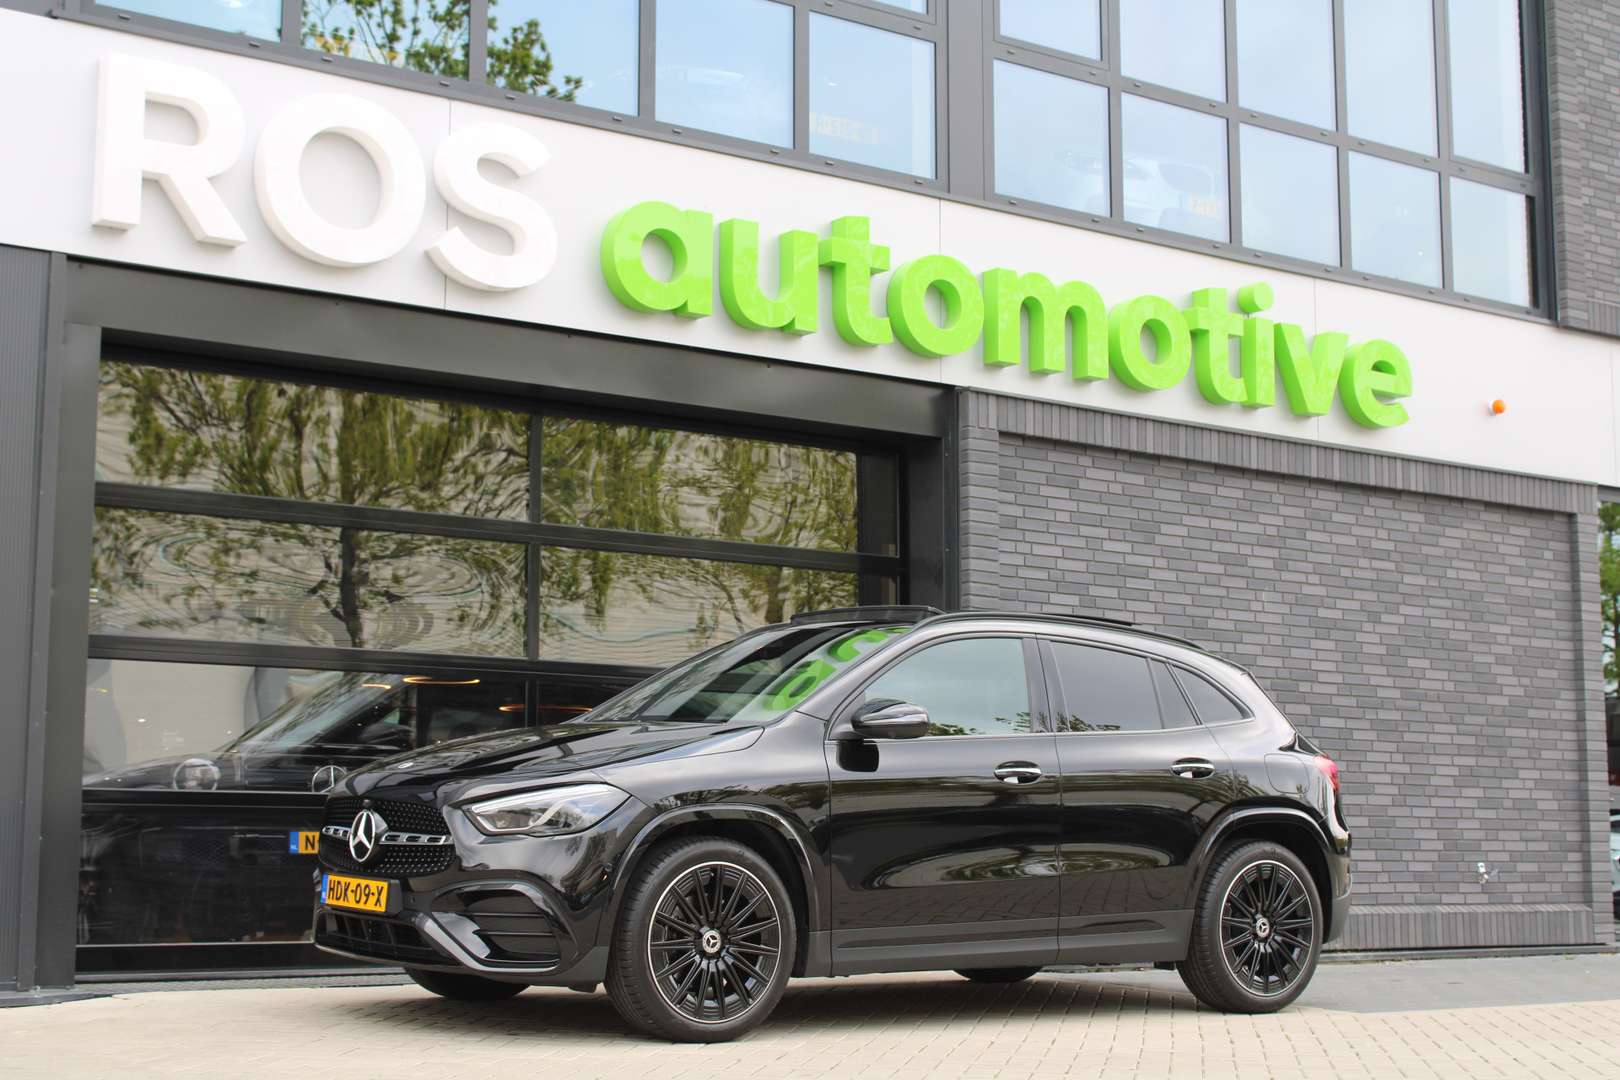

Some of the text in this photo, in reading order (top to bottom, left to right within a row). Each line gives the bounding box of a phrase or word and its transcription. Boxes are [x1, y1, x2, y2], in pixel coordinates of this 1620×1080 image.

[92, 52, 1413, 429] ROS automotive
[327, 879, 385, 908] HDK-09-X
